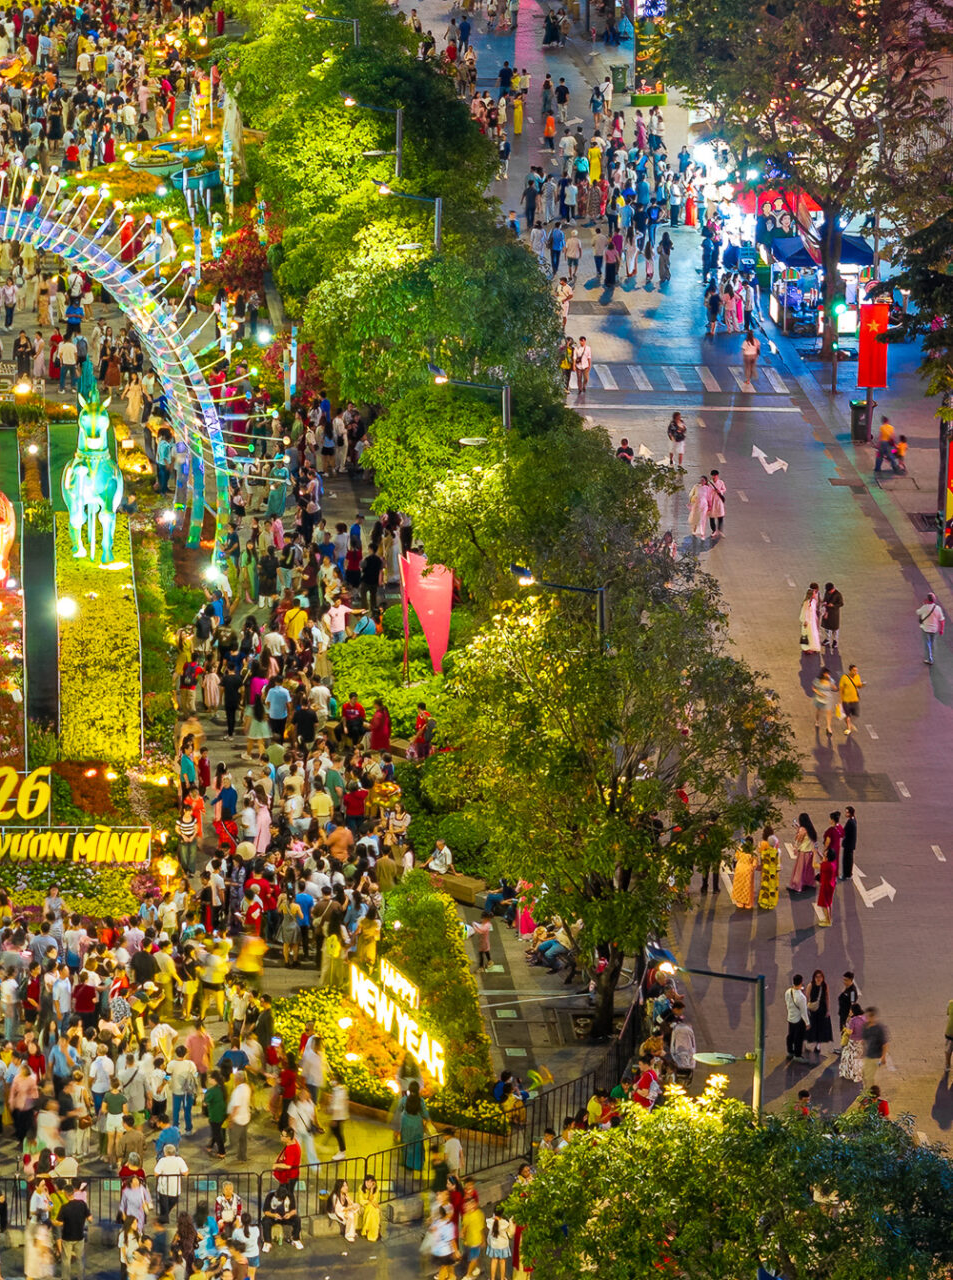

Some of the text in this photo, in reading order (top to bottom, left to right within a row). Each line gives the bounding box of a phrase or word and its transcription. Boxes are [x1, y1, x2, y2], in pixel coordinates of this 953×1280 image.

[73, 824, 152, 862] MÌNH
[350, 962, 445, 1087] NEW YEAR
